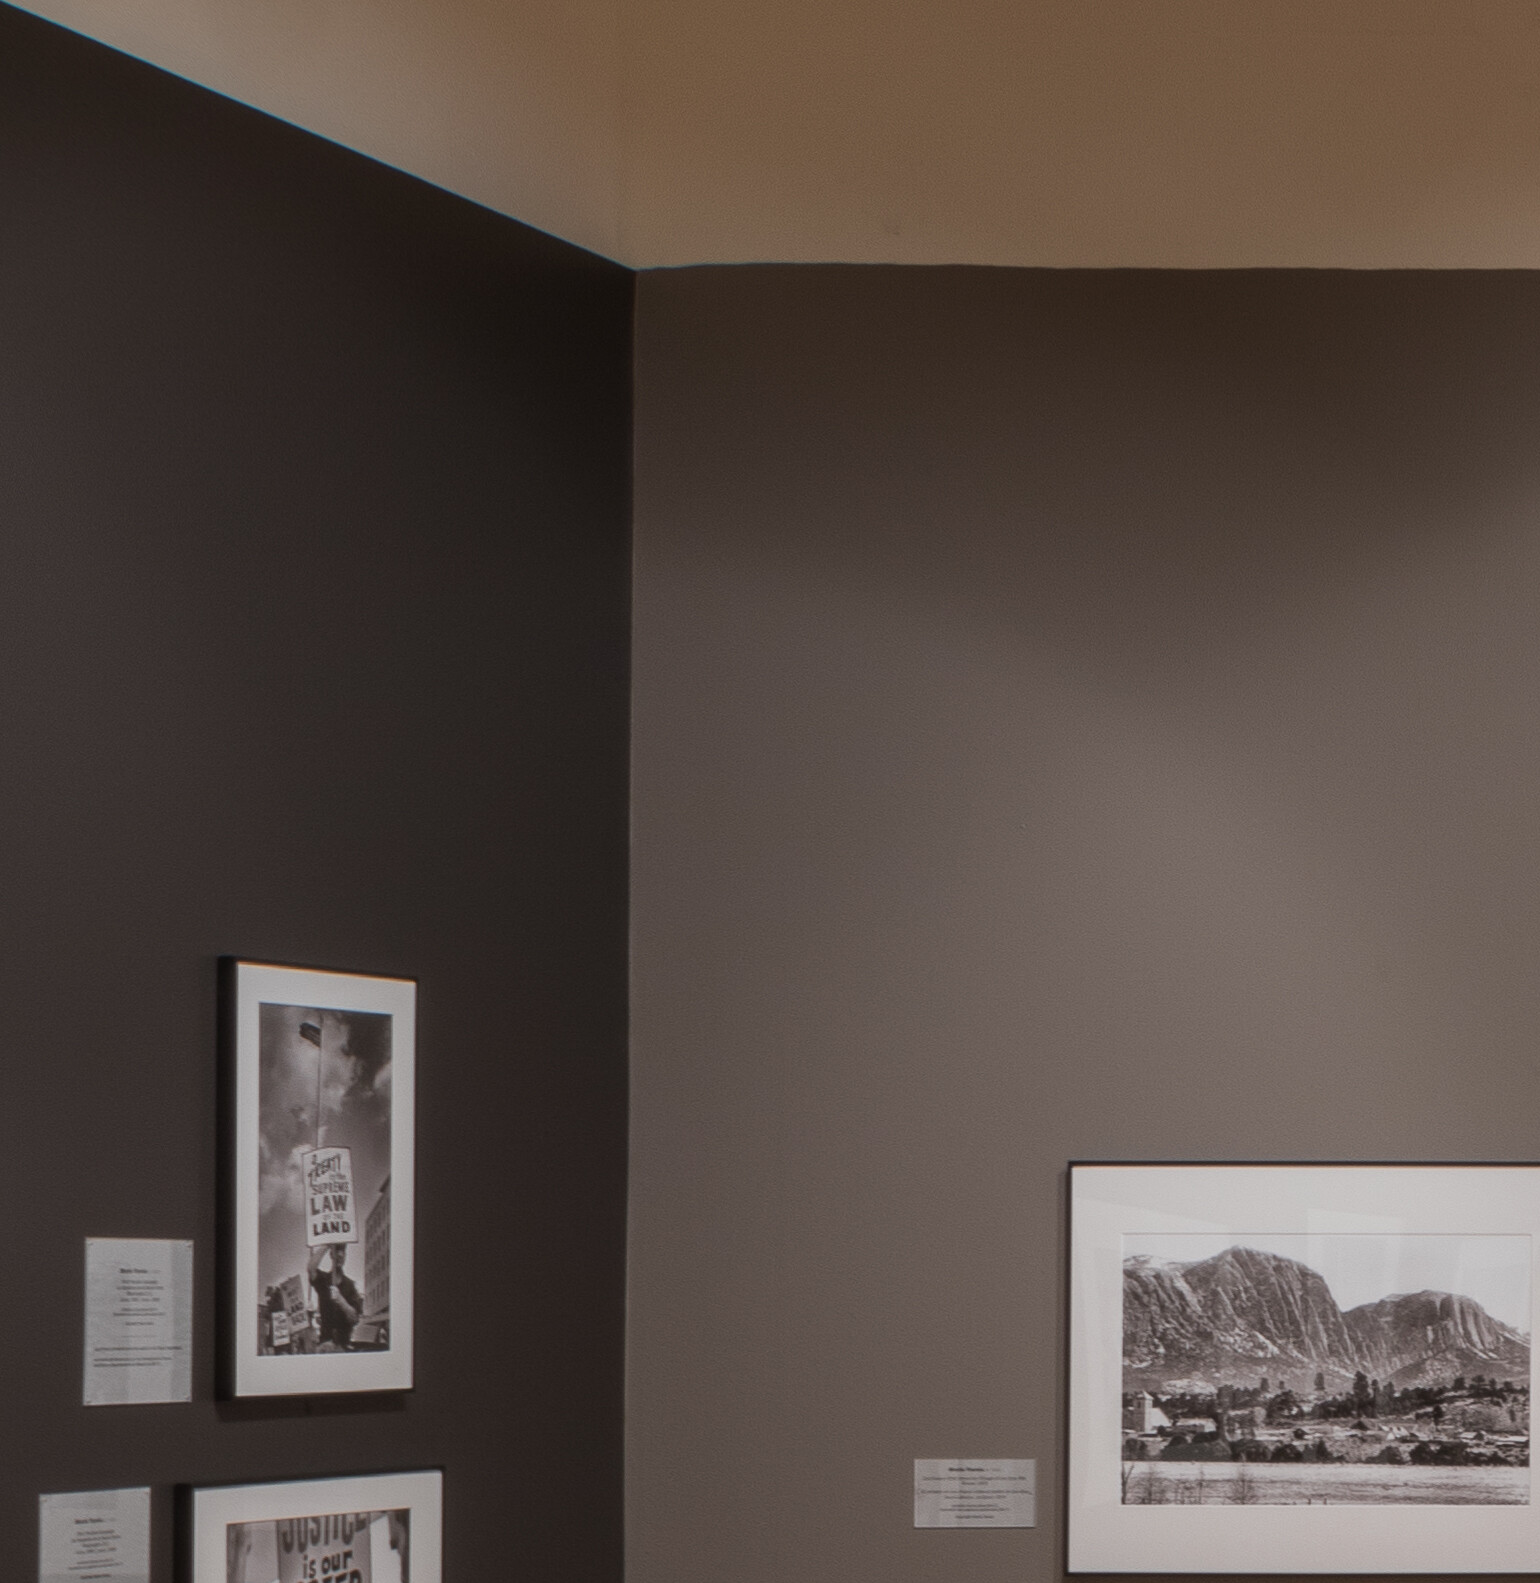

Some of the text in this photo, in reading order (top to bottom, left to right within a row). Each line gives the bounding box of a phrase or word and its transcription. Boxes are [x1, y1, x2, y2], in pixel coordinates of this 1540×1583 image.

[310, 1194, 348, 1216] LAW
[312, 1220, 352, 1237] LAND
[303, 1549, 353, 1579] is our
